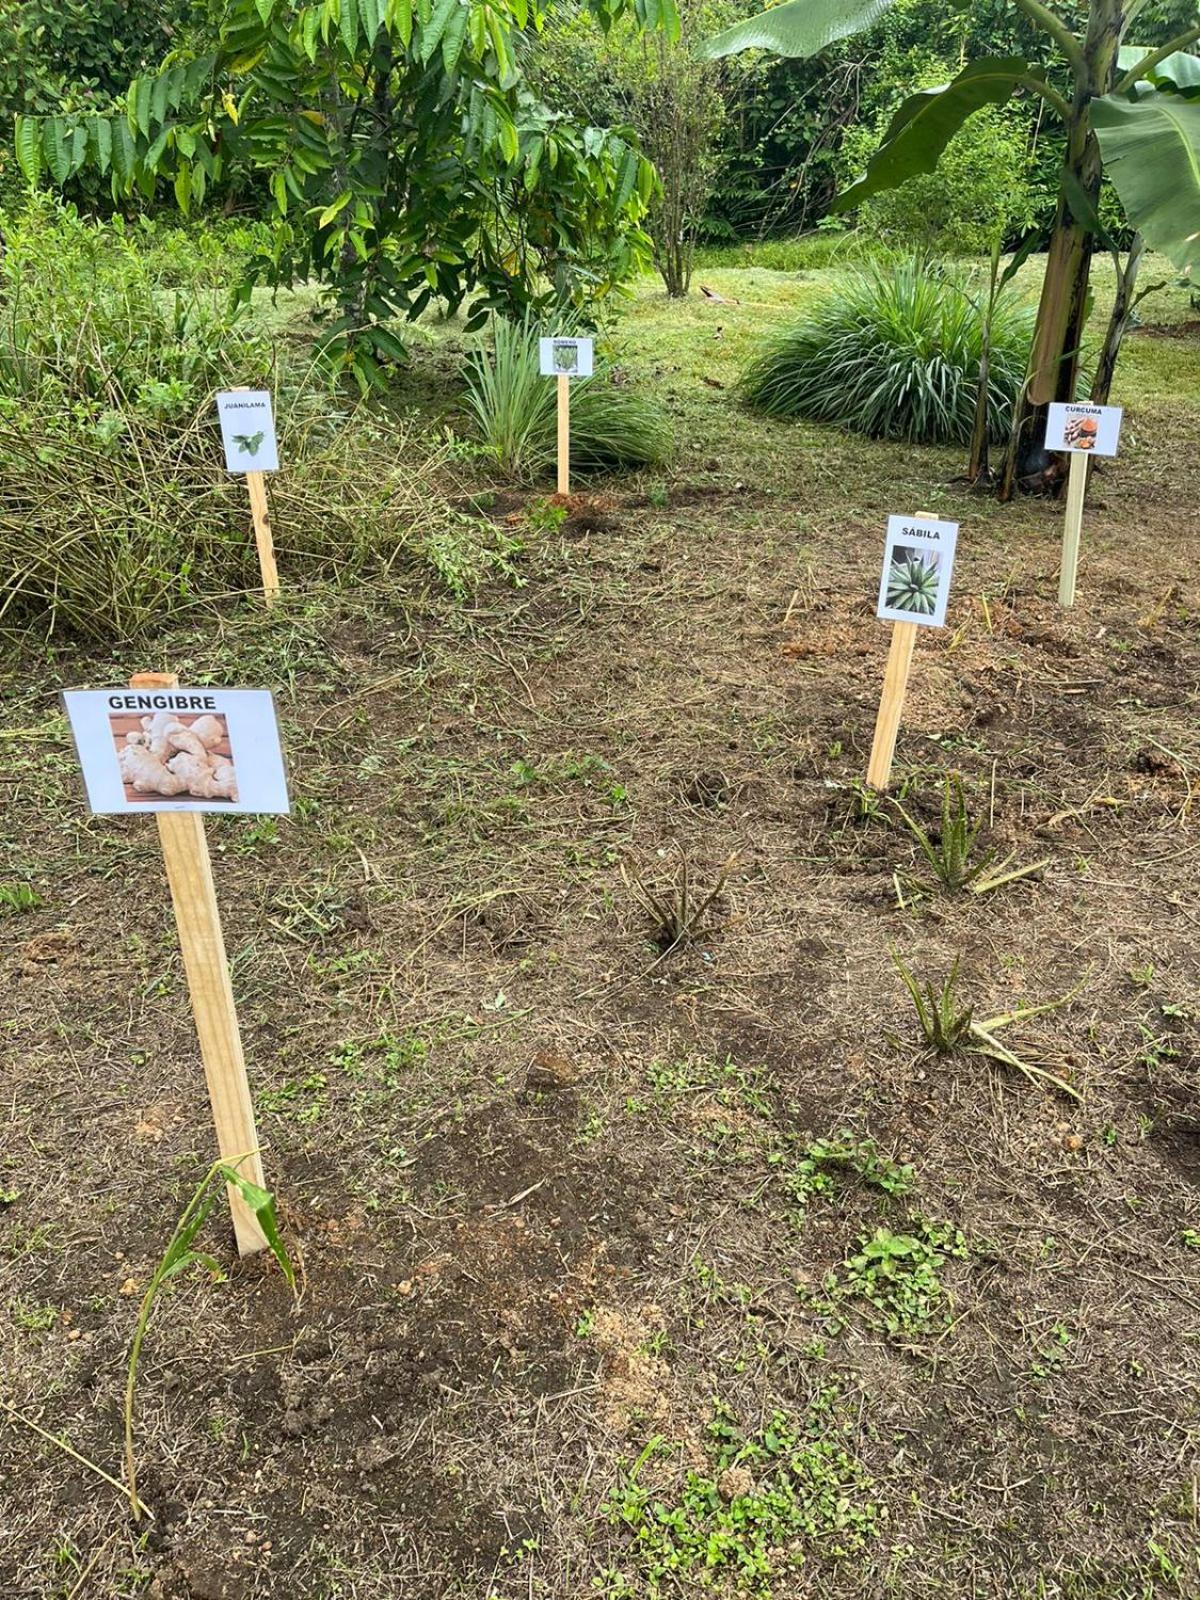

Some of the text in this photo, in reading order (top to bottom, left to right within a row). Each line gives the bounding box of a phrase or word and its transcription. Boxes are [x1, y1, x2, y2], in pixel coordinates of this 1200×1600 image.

[224, 402, 266, 410] JUANILAMA
[1065, 406, 1102, 415] CURCUMA
[902, 527, 940, 540] SÁBILA
[108, 695, 217, 710] GENGIBRE
